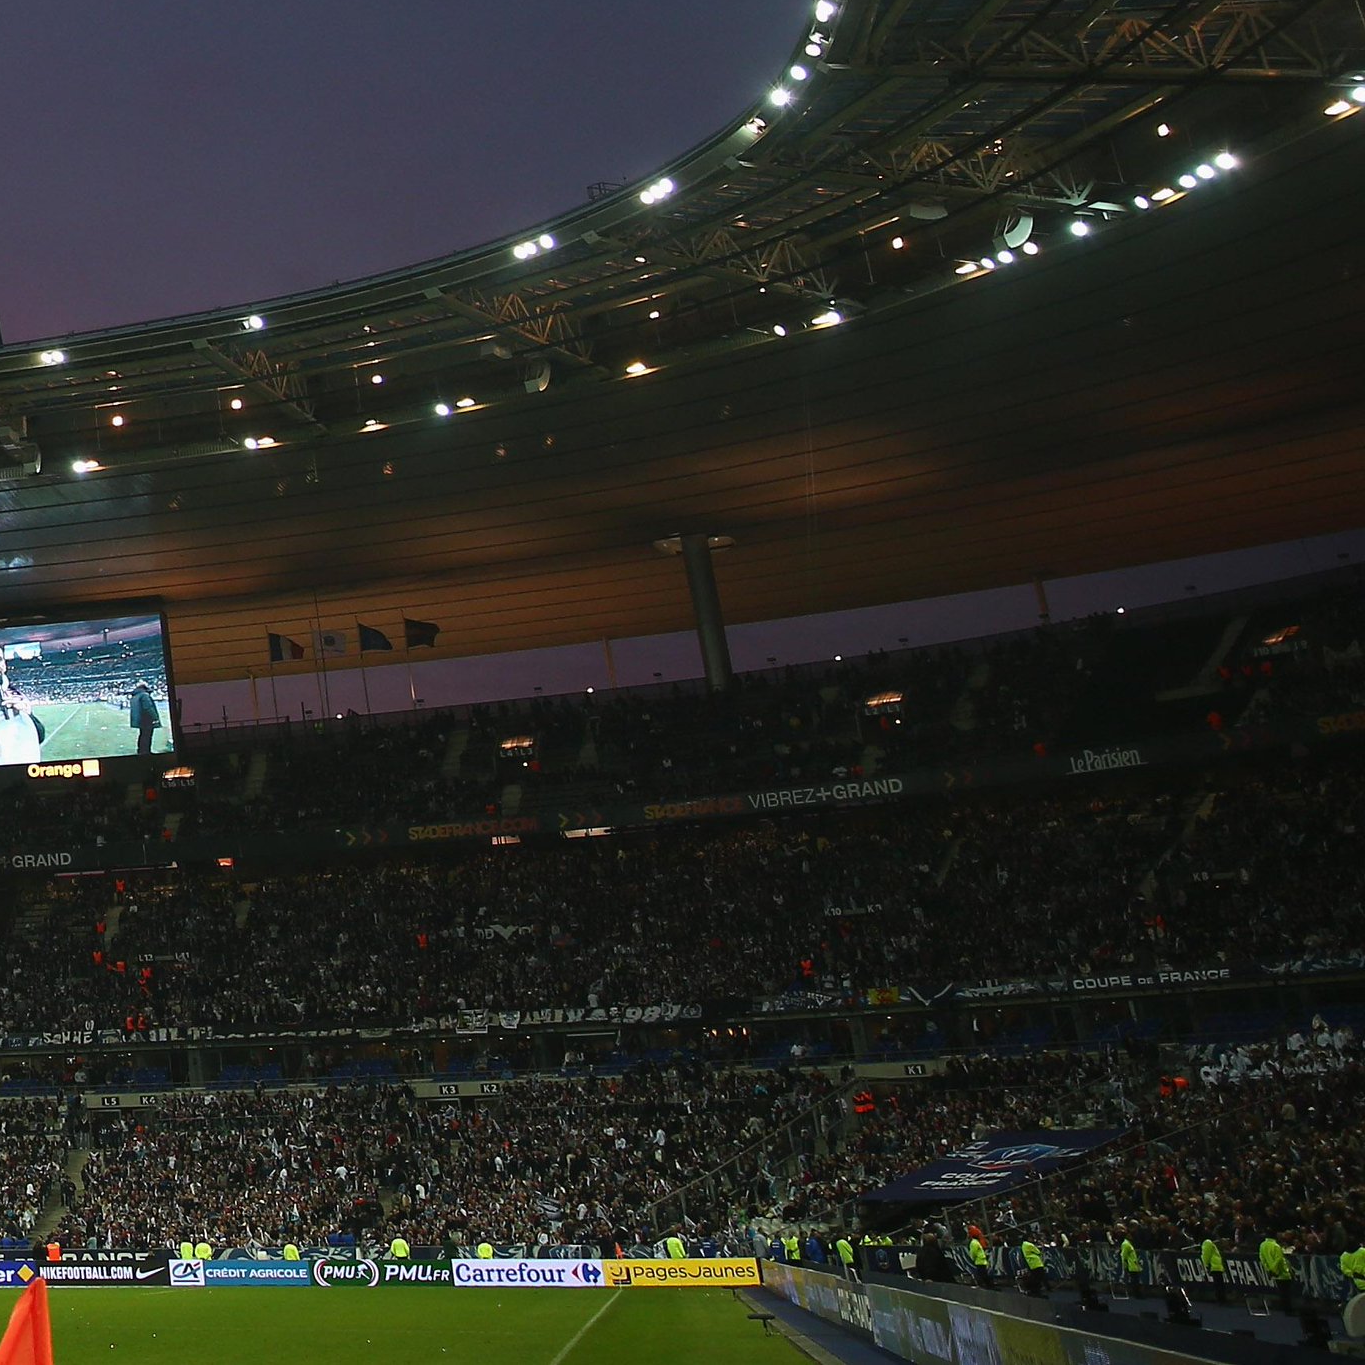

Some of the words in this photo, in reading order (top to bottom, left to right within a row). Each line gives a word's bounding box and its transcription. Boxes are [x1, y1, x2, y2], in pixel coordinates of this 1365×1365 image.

[27, 763, 81, 778] Orange
[1073, 975, 1132, 989] COUPE
[1160, 969, 1230, 984] FRANCE
[908, 1065, 923, 1074] K1
[441, 1085, 456, 1095] K3
[482, 1084, 498, 1093] K2
[104, 1098, 117, 1106] L5
[40, 1266, 133, 1280] NIKEFOOTBALL.COM
[206, 1266, 247, 1278] CRÉDIT
[249, 1268, 308, 1279] AGRICOLE
[324, 1265, 355, 1279] PMU
[385, 1265, 450, 1281] PMU.FR
[456, 1263, 565, 1283] Carrefour
[633, 1264, 756, 1280] PagesJaunes
